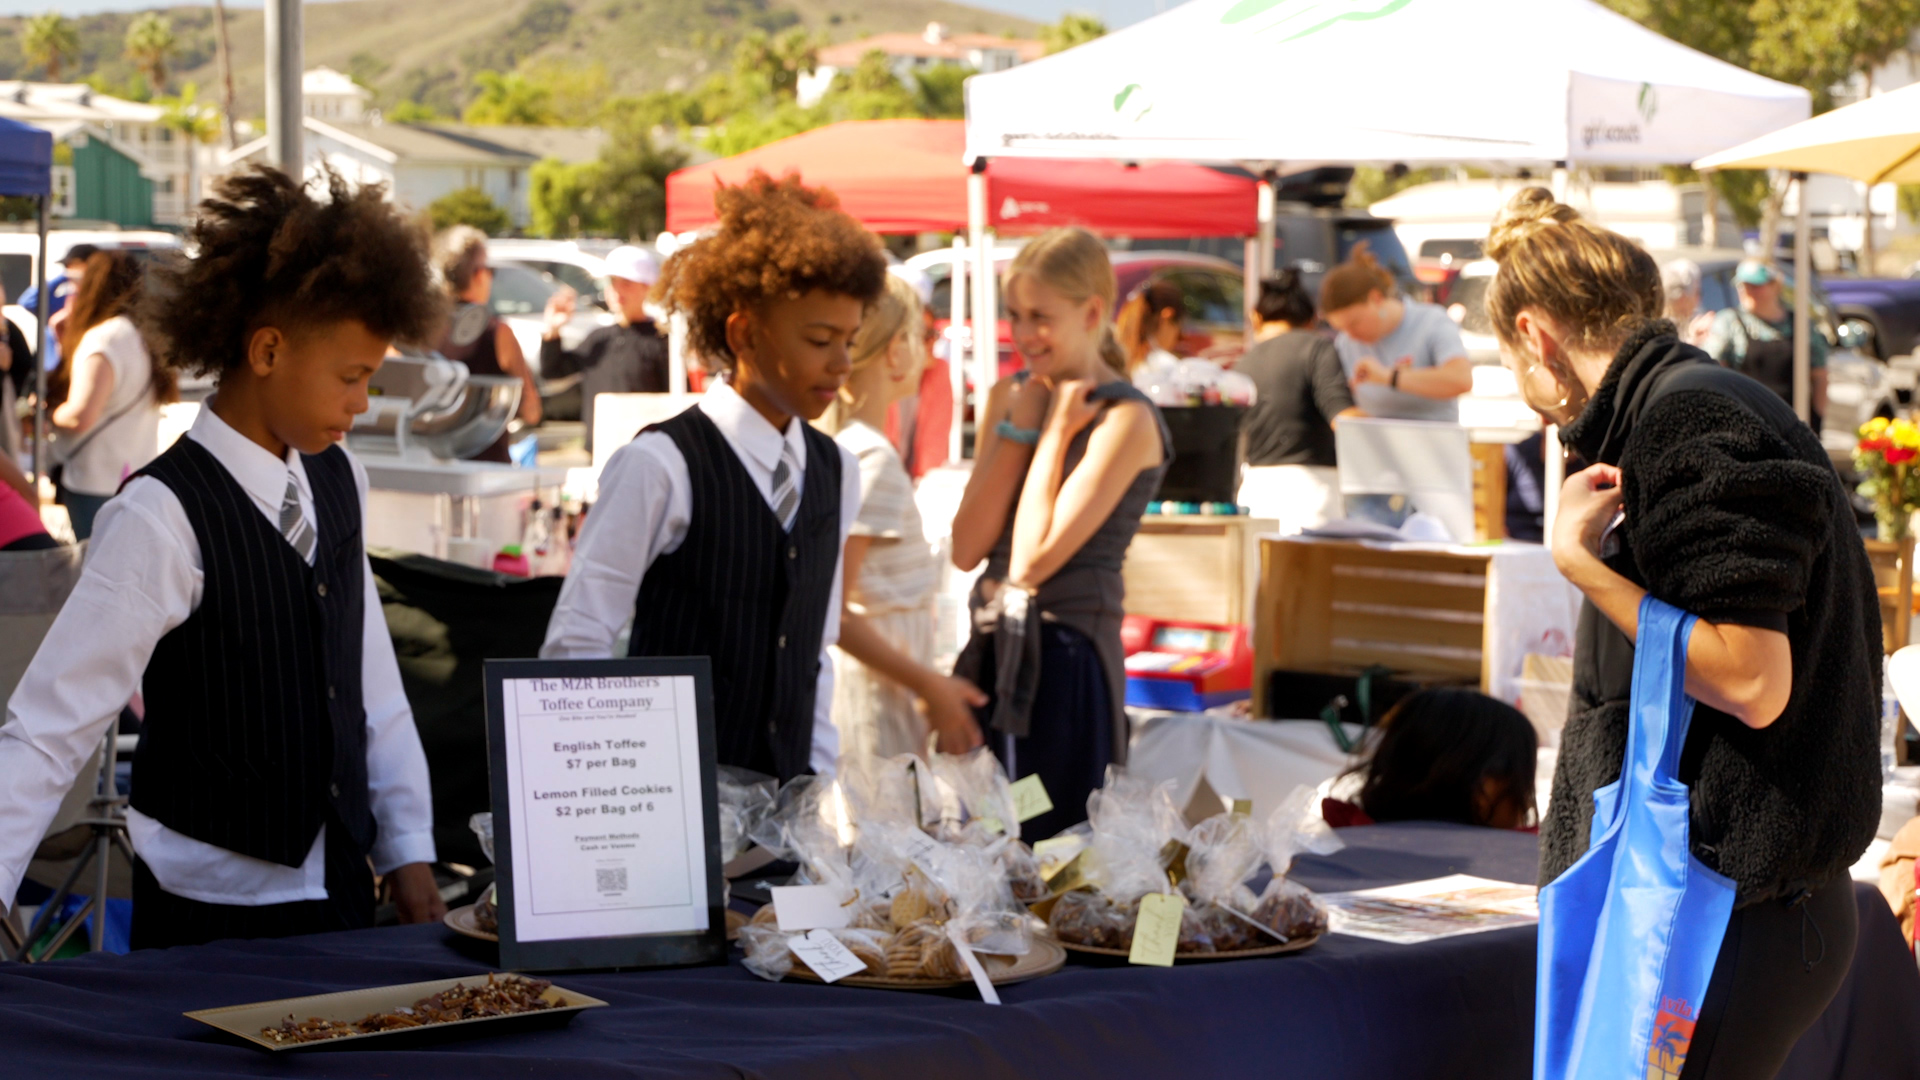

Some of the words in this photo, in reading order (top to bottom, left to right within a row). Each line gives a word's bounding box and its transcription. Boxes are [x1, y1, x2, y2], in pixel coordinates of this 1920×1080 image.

[530, 678, 557, 692] The
[562, 677, 594, 690] MZR
[598, 676, 659, 689] Brothers
[540, 697, 584, 711] Toffee
[587, 696, 653, 712] Company
[554, 741, 601, 753] English
[605, 739, 647, 750] Toffee
[566, 758, 582, 770] $7
[586, 760, 607, 770] per
[612, 757, 637, 769] Bag
[533, 790, 578, 801] Lemon
[582, 787, 617, 798] Filled
[621, 784, 673, 796] Cookies
[556, 805, 571, 818] $2
[576, 806, 597, 818] per
[601, 803, 626, 815] Bag
[630, 801, 643, 813] of
[647, 801, 655, 812] 6
[575, 834, 607, 843] Payment
[580, 843, 599, 851] Cash
